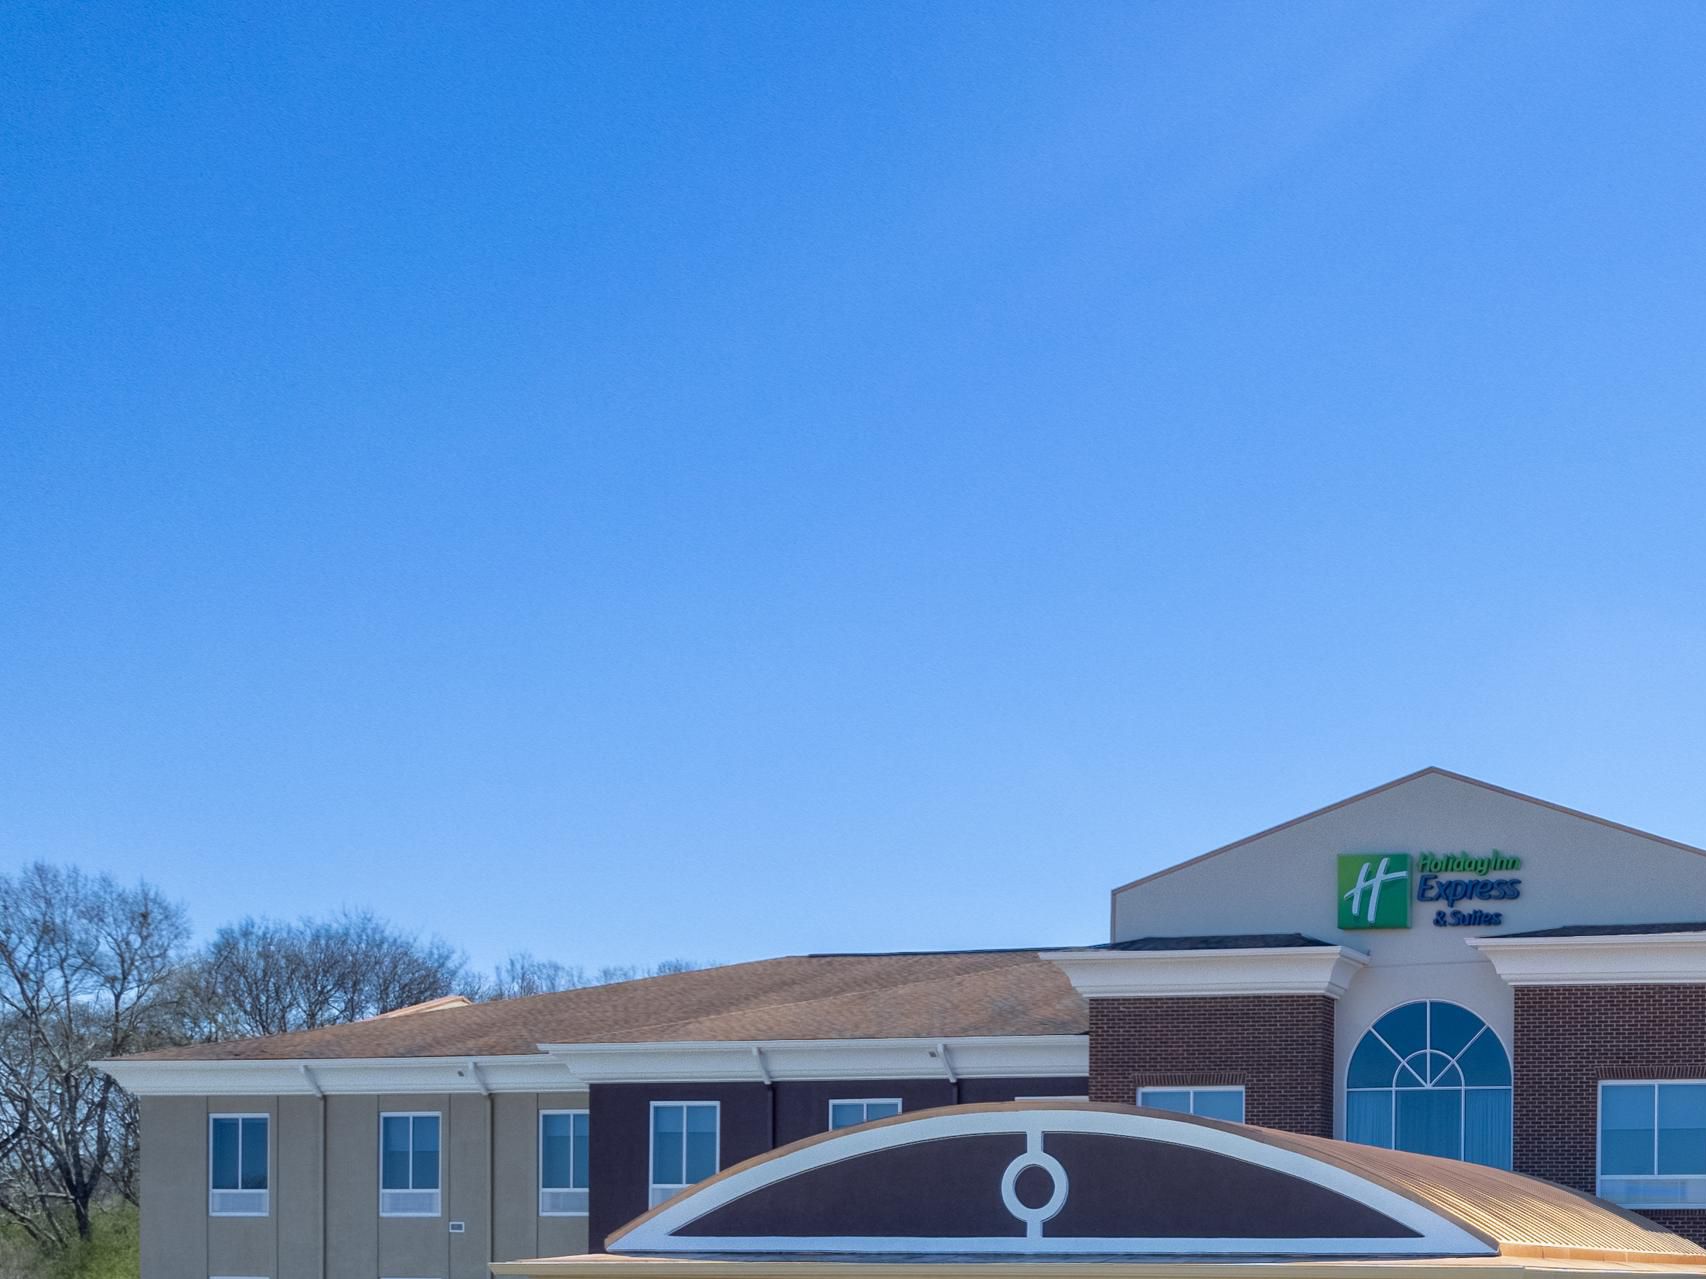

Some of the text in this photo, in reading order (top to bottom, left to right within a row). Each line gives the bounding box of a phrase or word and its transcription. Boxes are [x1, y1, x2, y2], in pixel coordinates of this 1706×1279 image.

[1418, 848, 1521, 876] Holiday Inn
[1343, 857, 1408, 924] H
[1417, 874, 1522, 908] Express
[1433, 909, 1503, 927] & Suites
